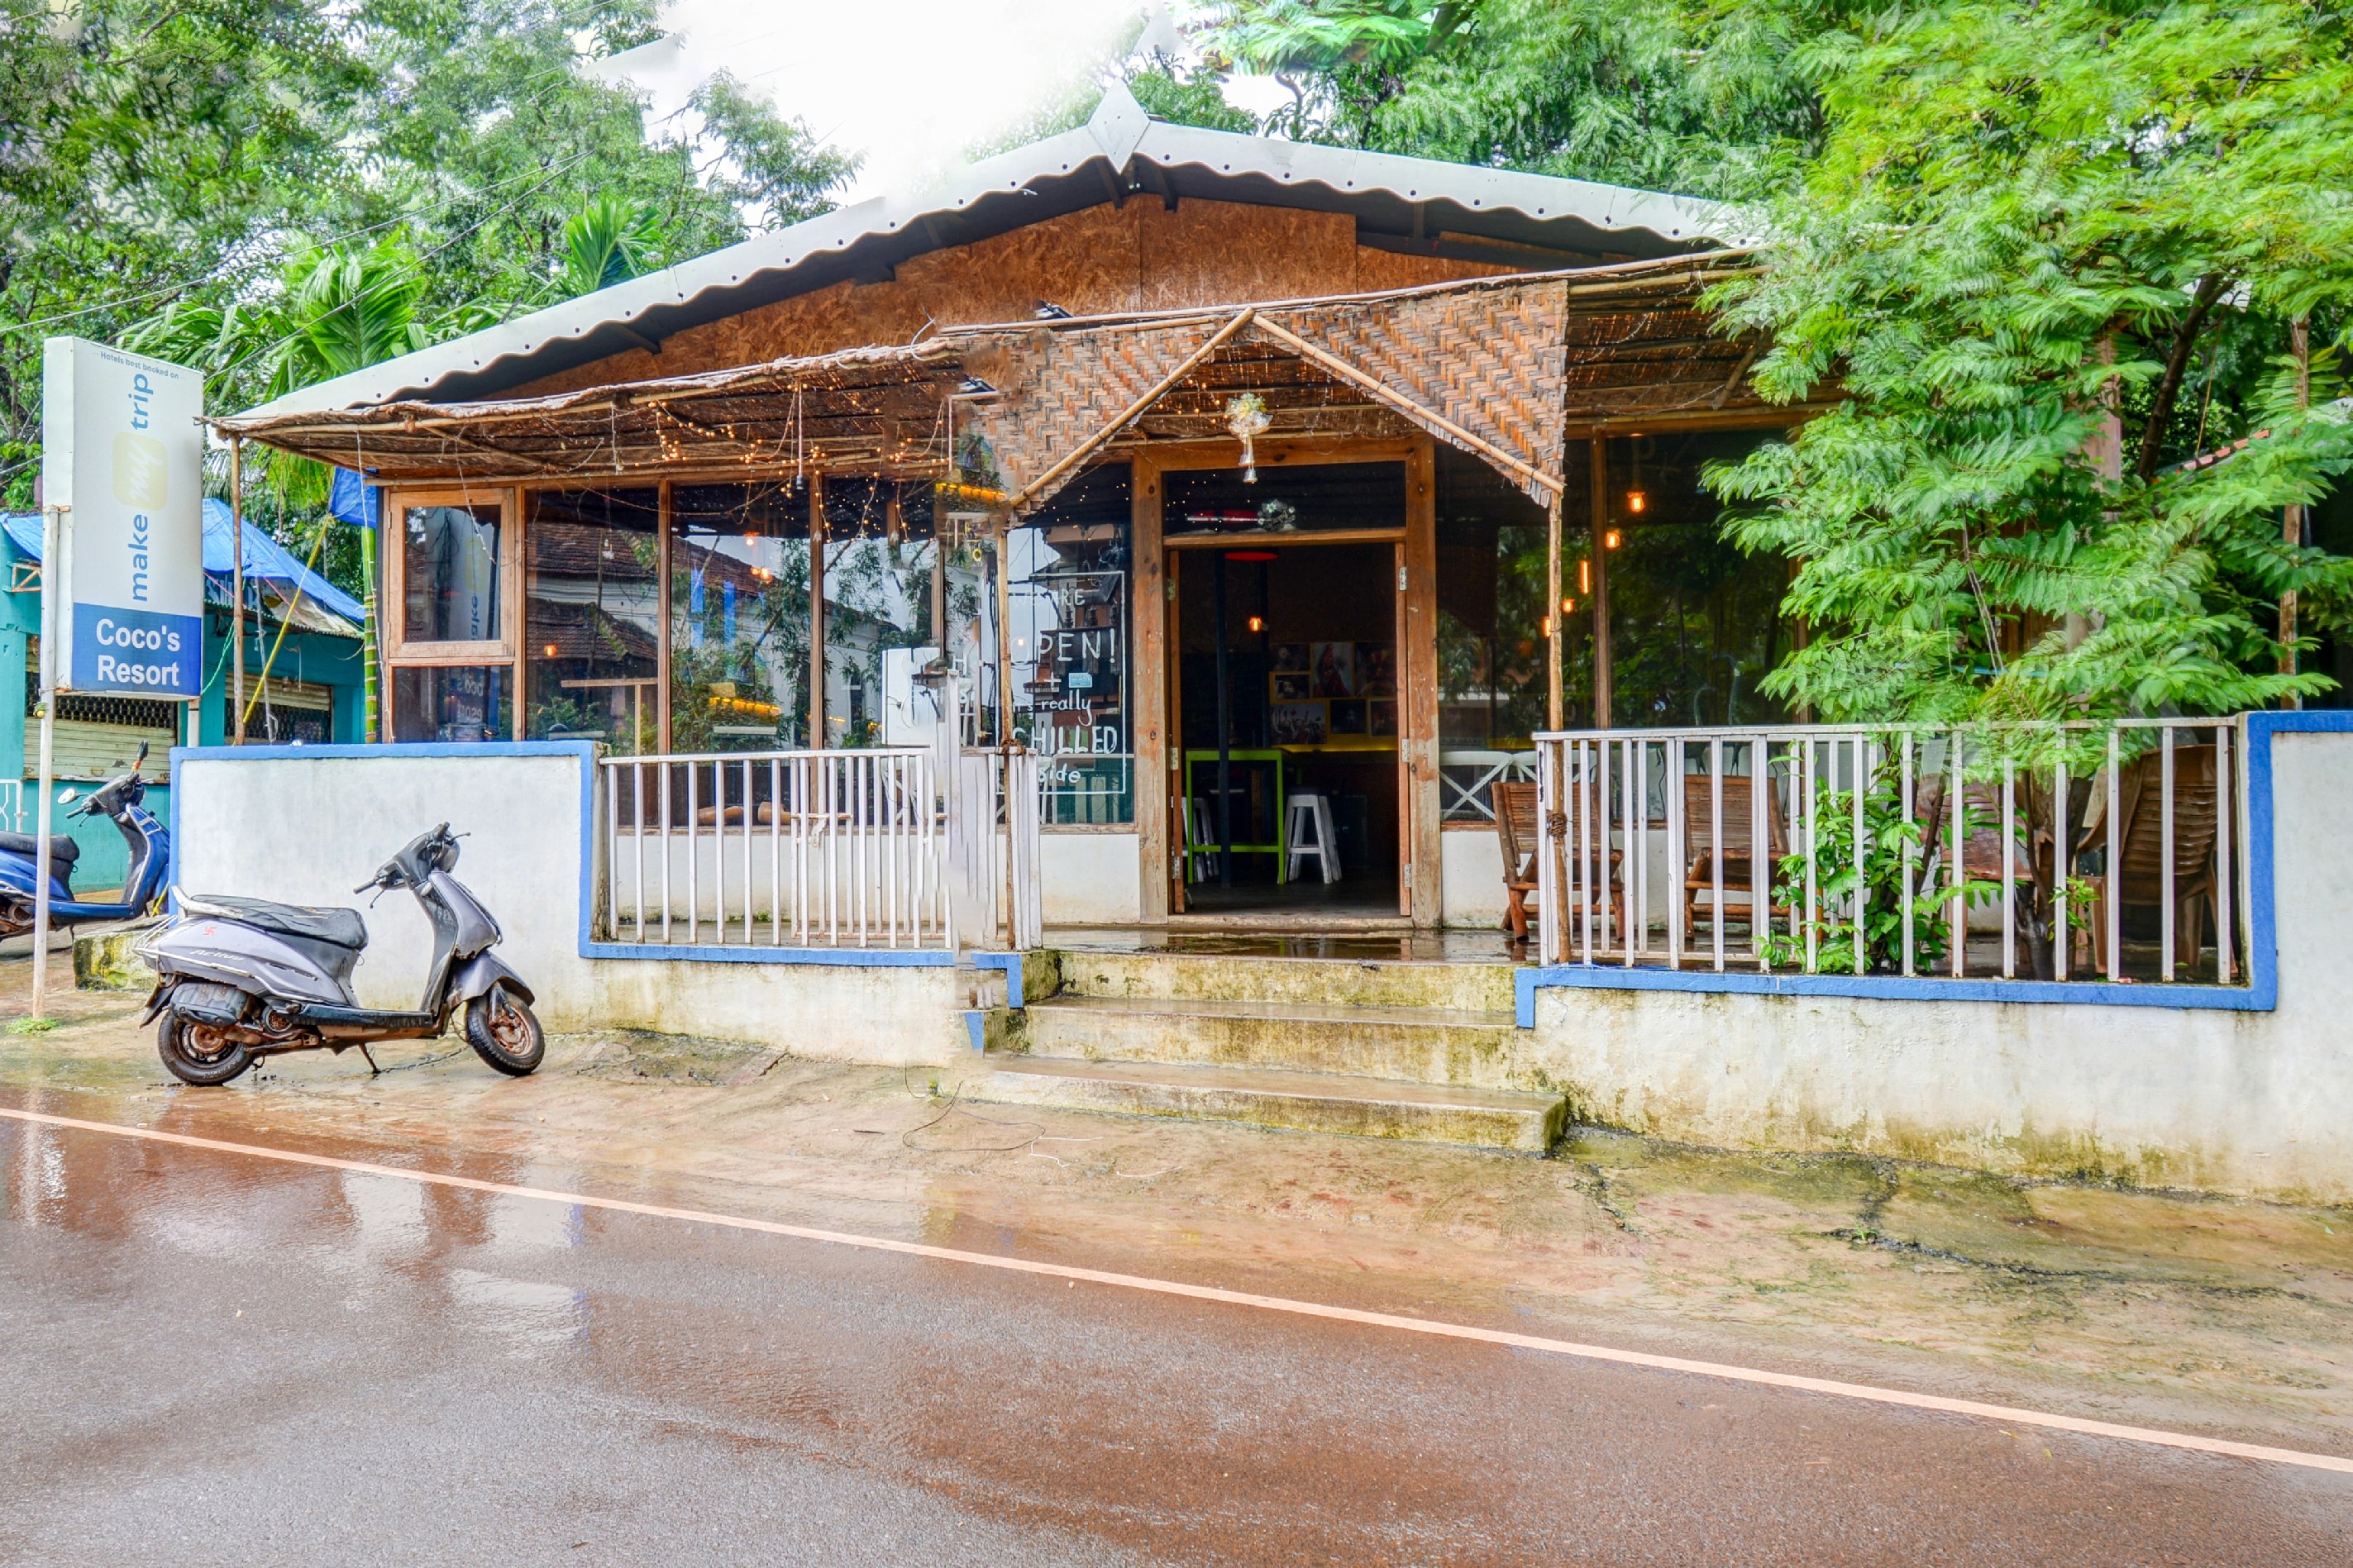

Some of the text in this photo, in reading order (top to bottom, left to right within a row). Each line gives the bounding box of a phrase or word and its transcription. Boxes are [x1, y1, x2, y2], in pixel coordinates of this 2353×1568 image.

[100, 351, 124, 365] Hotels
[125, 358, 141, 369] best
[142, 364, 169, 377] booked
[127, 374, 154, 430] trip
[127, 514, 149, 602] make
[96, 618, 180, 652] Coco's
[98, 655, 180, 687] Resort
[1041, 689, 1092, 727] really
